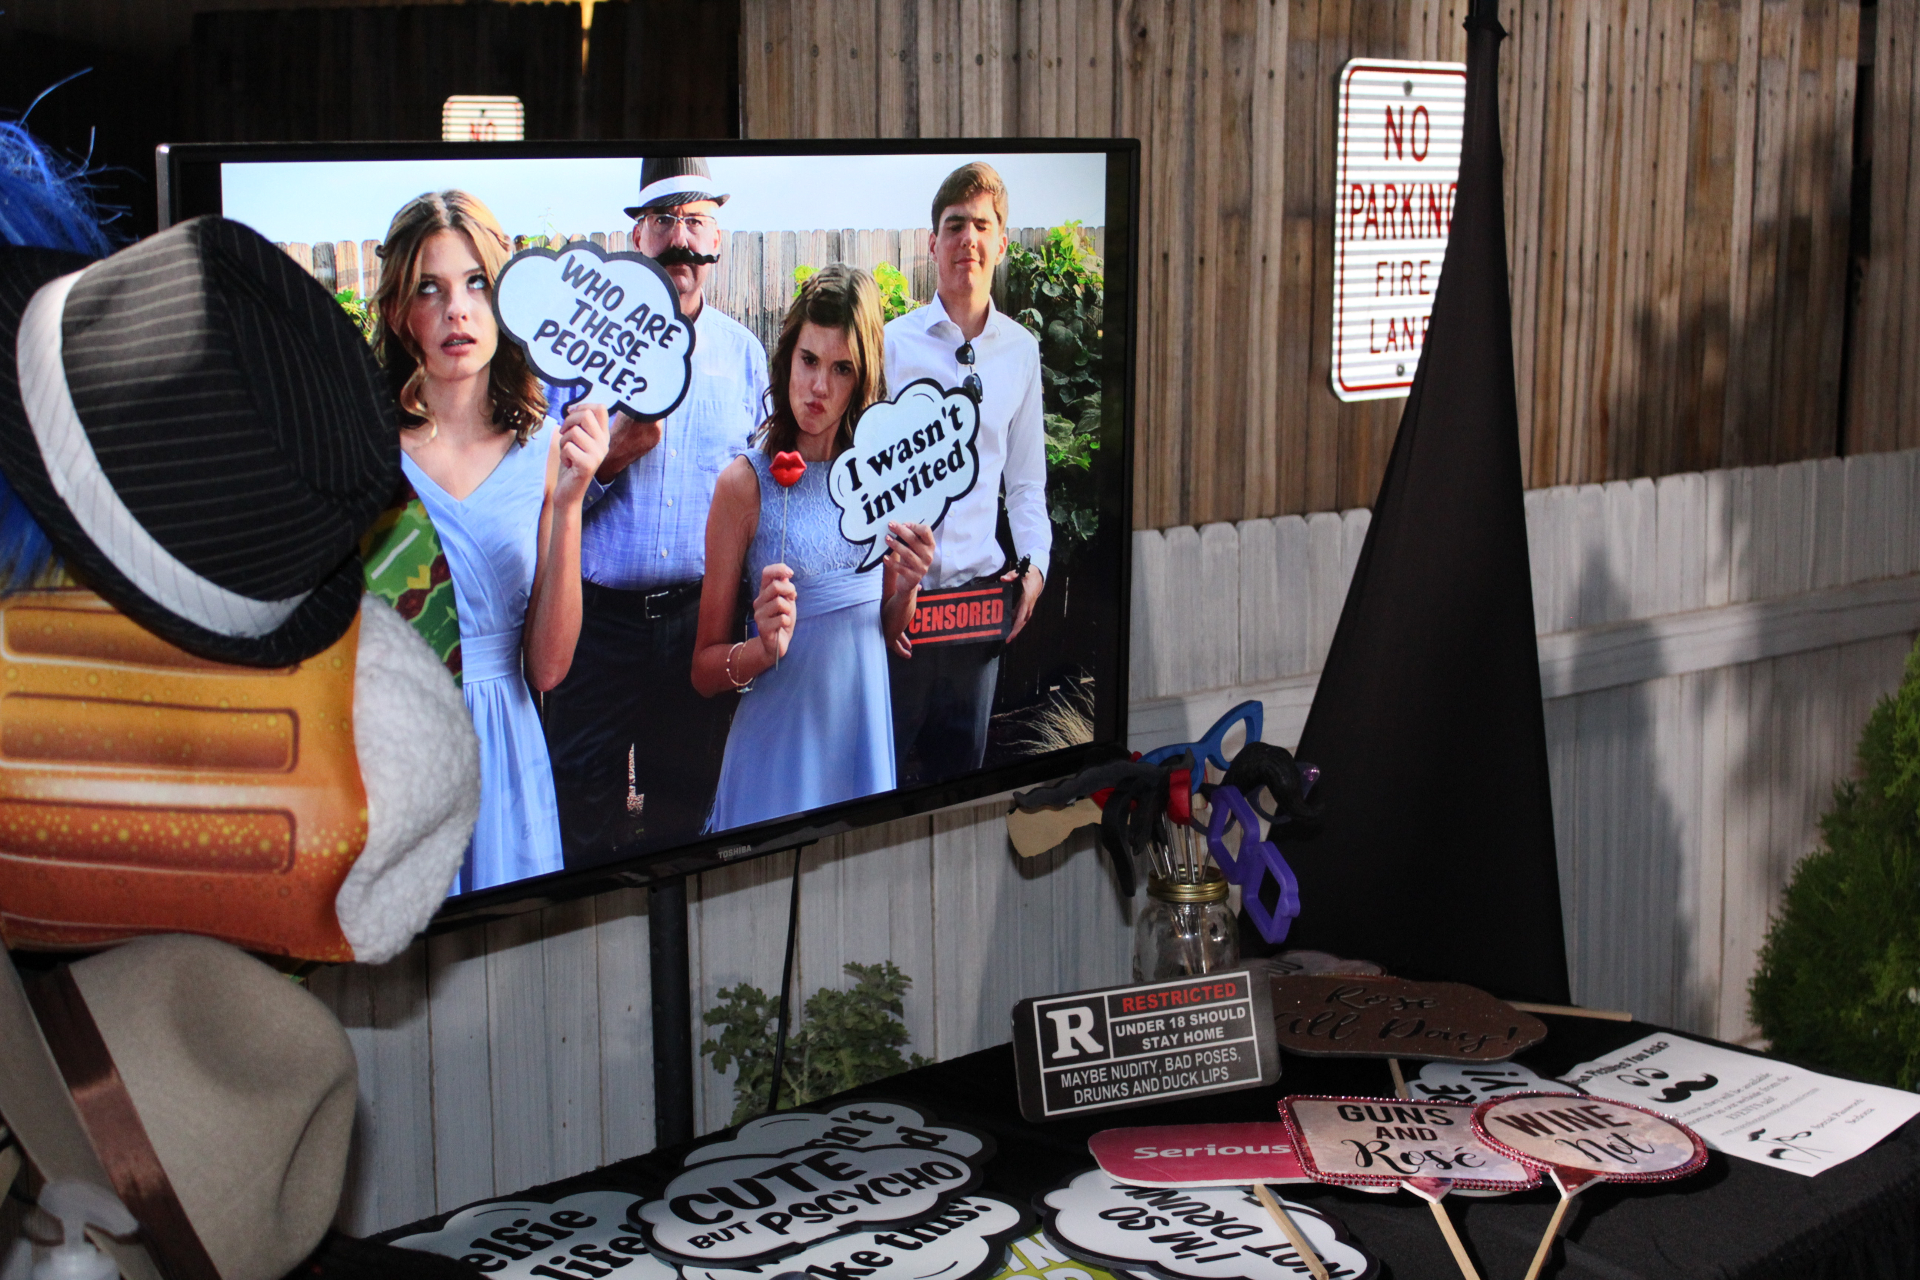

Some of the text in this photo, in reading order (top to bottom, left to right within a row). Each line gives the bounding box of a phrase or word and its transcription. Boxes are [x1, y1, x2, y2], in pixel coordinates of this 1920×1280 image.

[1384, 104, 1430, 162] NO
[561, 254, 682, 349] WHO ARE
[1375, 260, 1431, 297] FIRE
[569, 298, 649, 365] THESE
[532, 319, 648, 401] PEOPLE?
[844, 403, 963, 492] I wasn't
[860, 439, 966, 525] invited
[908, 599, 1004, 635] CENSORED
[718, 844, 752, 859] TOSHIBA
[1122, 981, 1237, 1013] RESTRICTED
[1045, 1005, 1104, 1060] R
[1115, 1006, 1246, 1038] UNDER 18 SHOULD
[1142, 1026, 1225, 1050] STAY HOME
[1060, 1047, 1242, 1088] MAYBE NUDITY, BAD POSES,
[1073, 1066, 1230, 1105] DRUNKS AND DUCK LIPS
[1335, 1103, 1456, 1127] GUNS
[1375, 1125, 1439, 1141] AND
[1493, 1104, 1632, 1138] WINE
[1133, 1142, 1292, 1160] Serious
[668, 1150, 868, 1226] CUTE
[687, 1160, 964, 1250] BUT PSCYCHO
[458, 1209, 598, 1273] elfie
[529, 1223, 651, 1280] life
[1098, 1206, 1242, 1264] I'M SO
